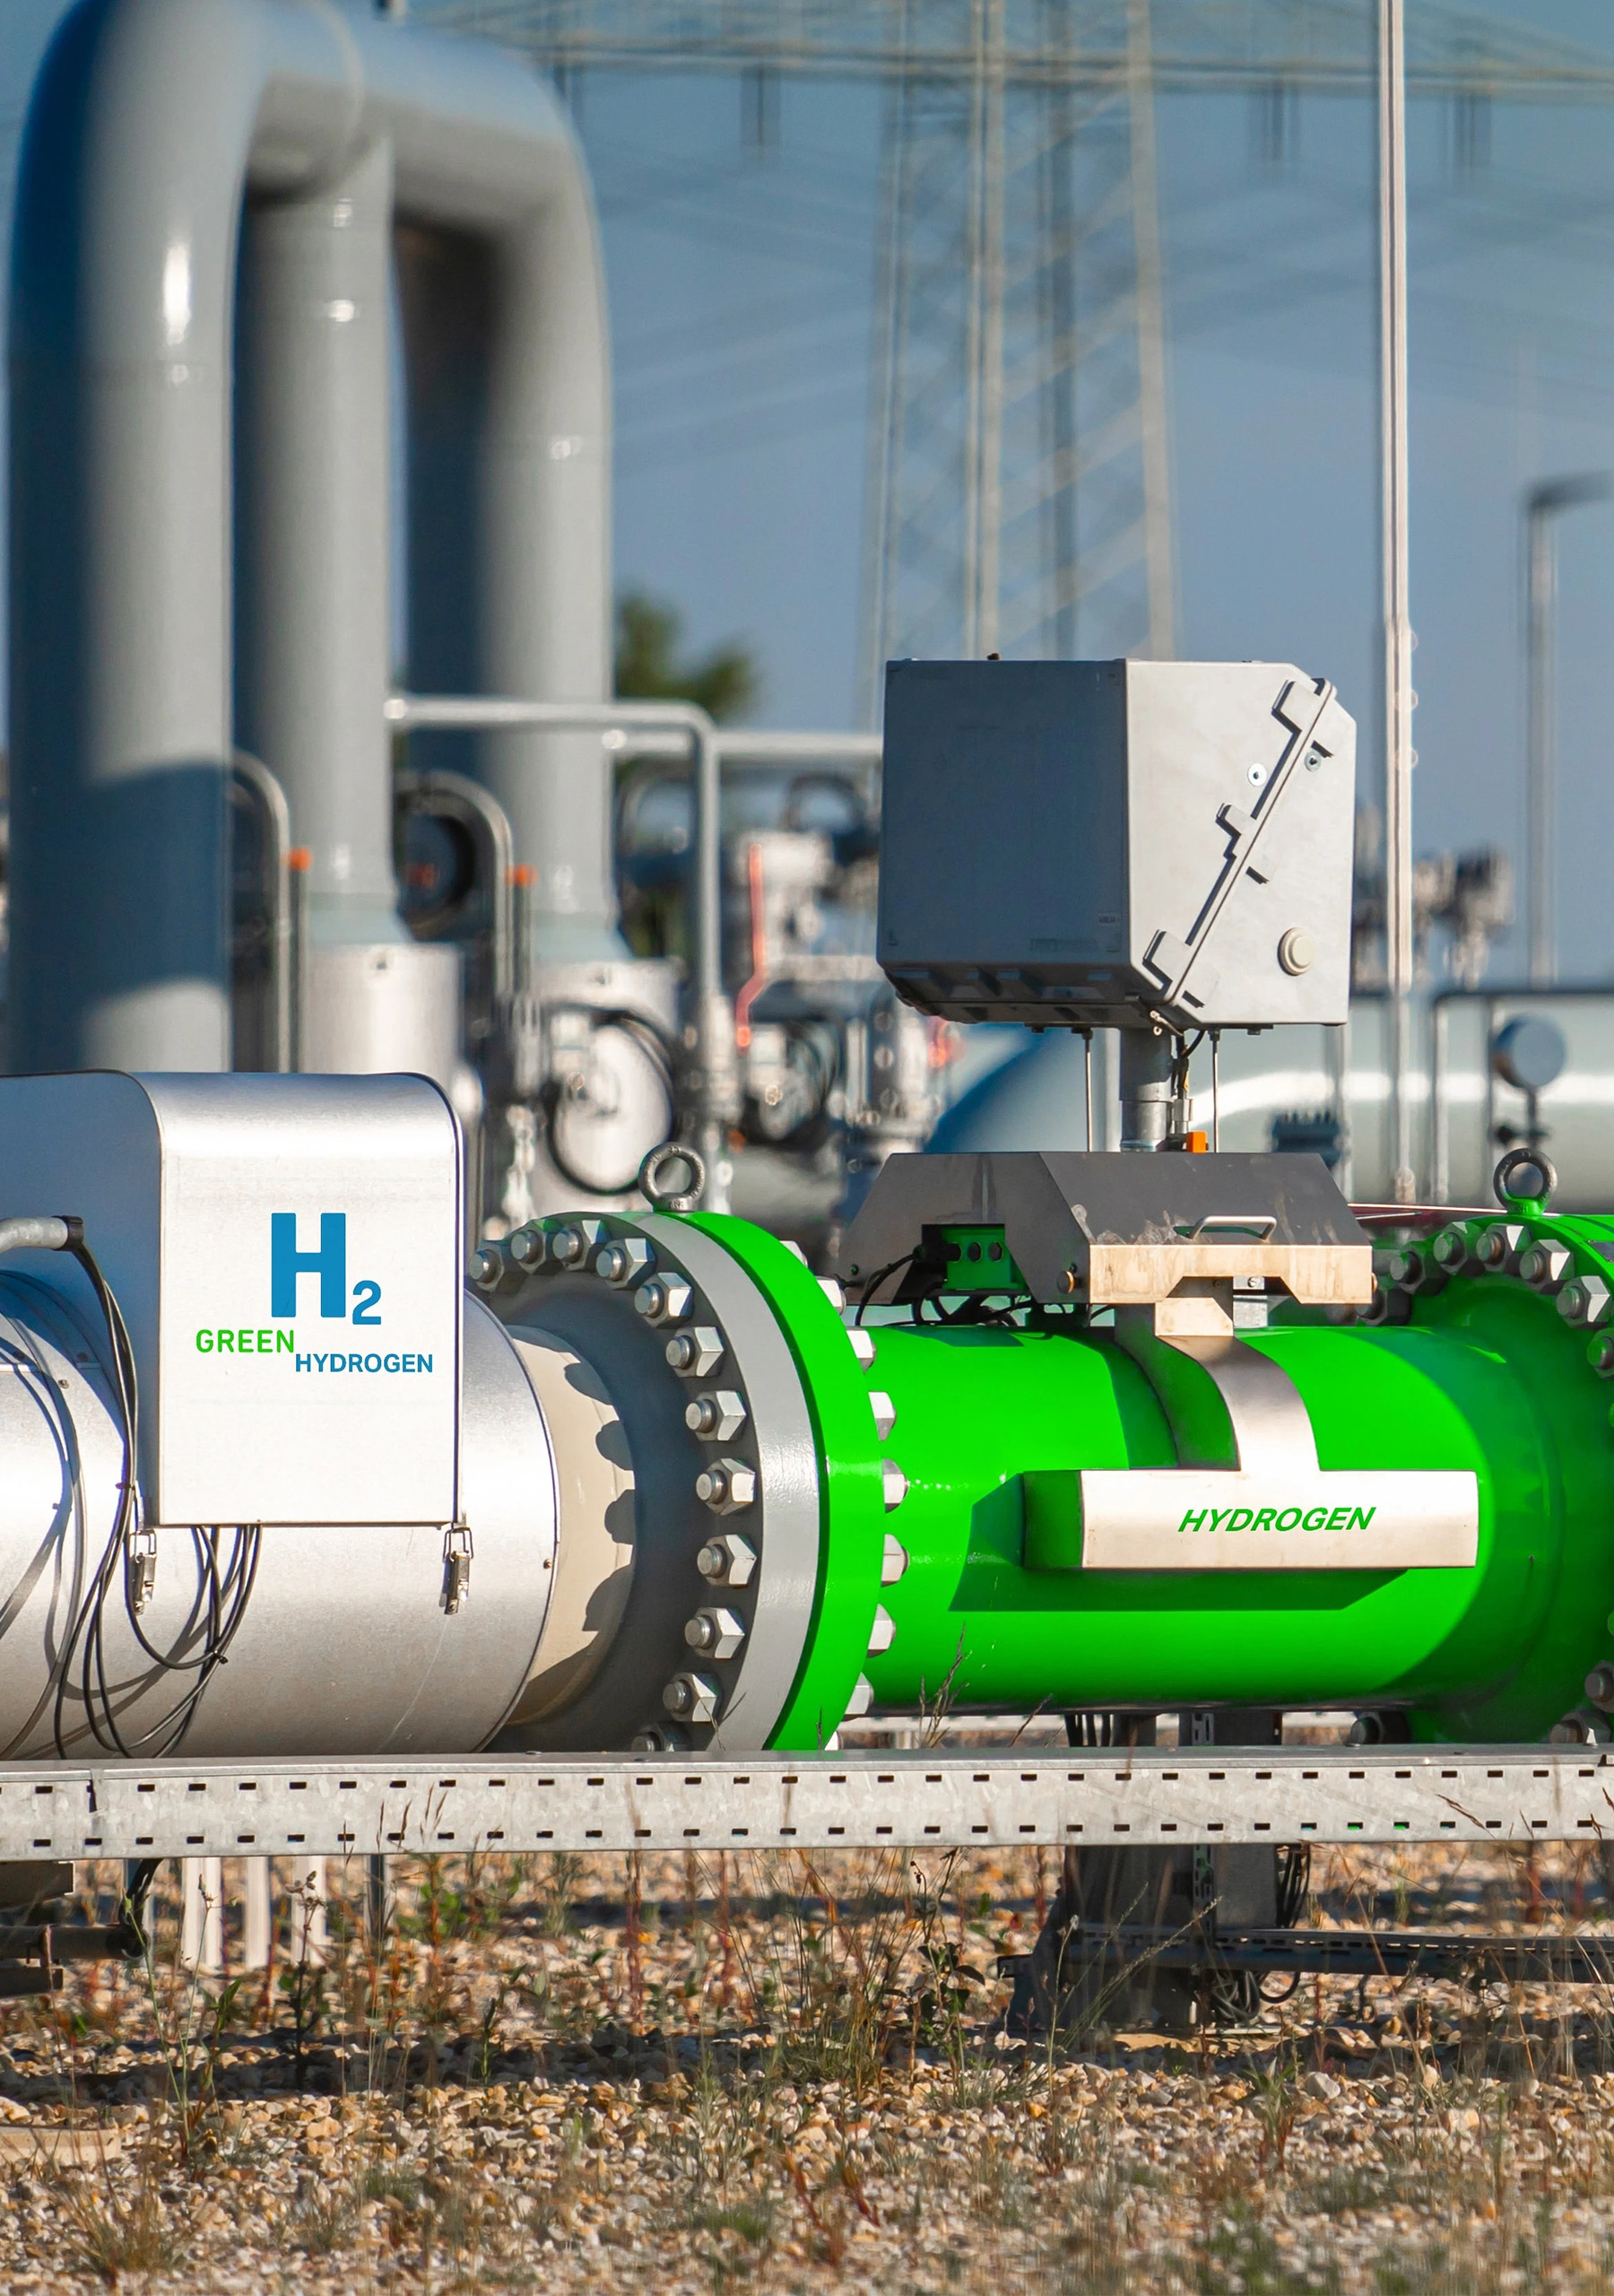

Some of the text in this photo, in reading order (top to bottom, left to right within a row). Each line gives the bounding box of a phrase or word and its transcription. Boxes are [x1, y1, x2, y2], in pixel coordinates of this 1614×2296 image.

[195, 1328, 295, 1353] GREEN
[295, 1352, 434, 1373] HYDROGEN
[1177, 1506, 1376, 1533] HYDROGEN
